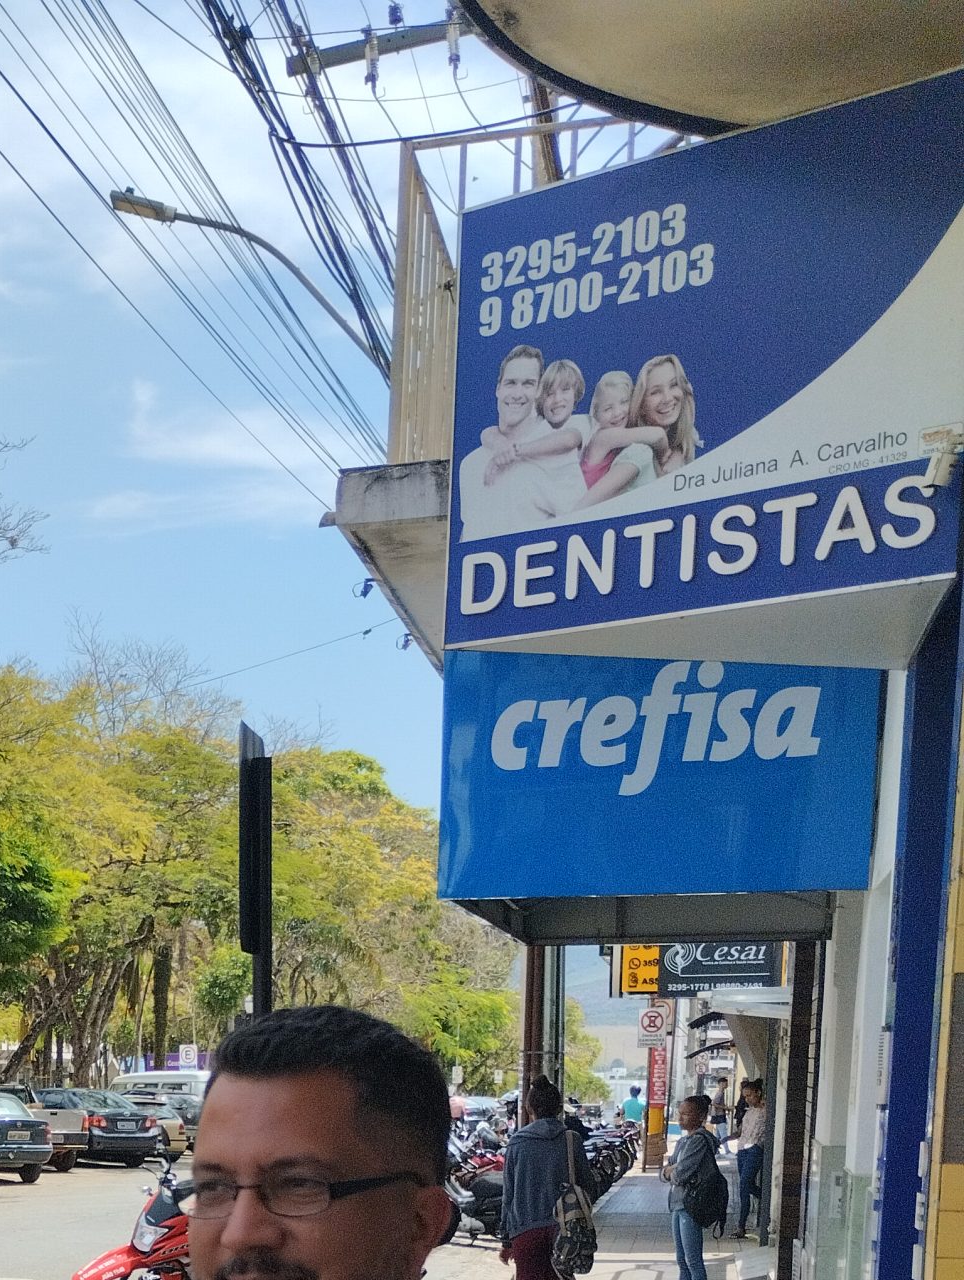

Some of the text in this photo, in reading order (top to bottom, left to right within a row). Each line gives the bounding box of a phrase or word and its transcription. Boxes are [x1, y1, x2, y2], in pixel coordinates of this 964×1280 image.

[479, 243, 715, 337] 9 8700-2103
[481, 203, 687, 292] 3295-2103
[673, 469, 705, 492] Dra
[711, 455, 778, 487] Juliana
[790, 446, 809, 469] A.
[817, 431, 908, 462] Carvalho
[828, 462, 851, 475] CRO
[853, 459, 870, 469] MG
[460, 474, 938, 616] DENTISTAS
[490, 660, 822, 797] crefisa
[667, 983, 710, 991] 3295-1778
